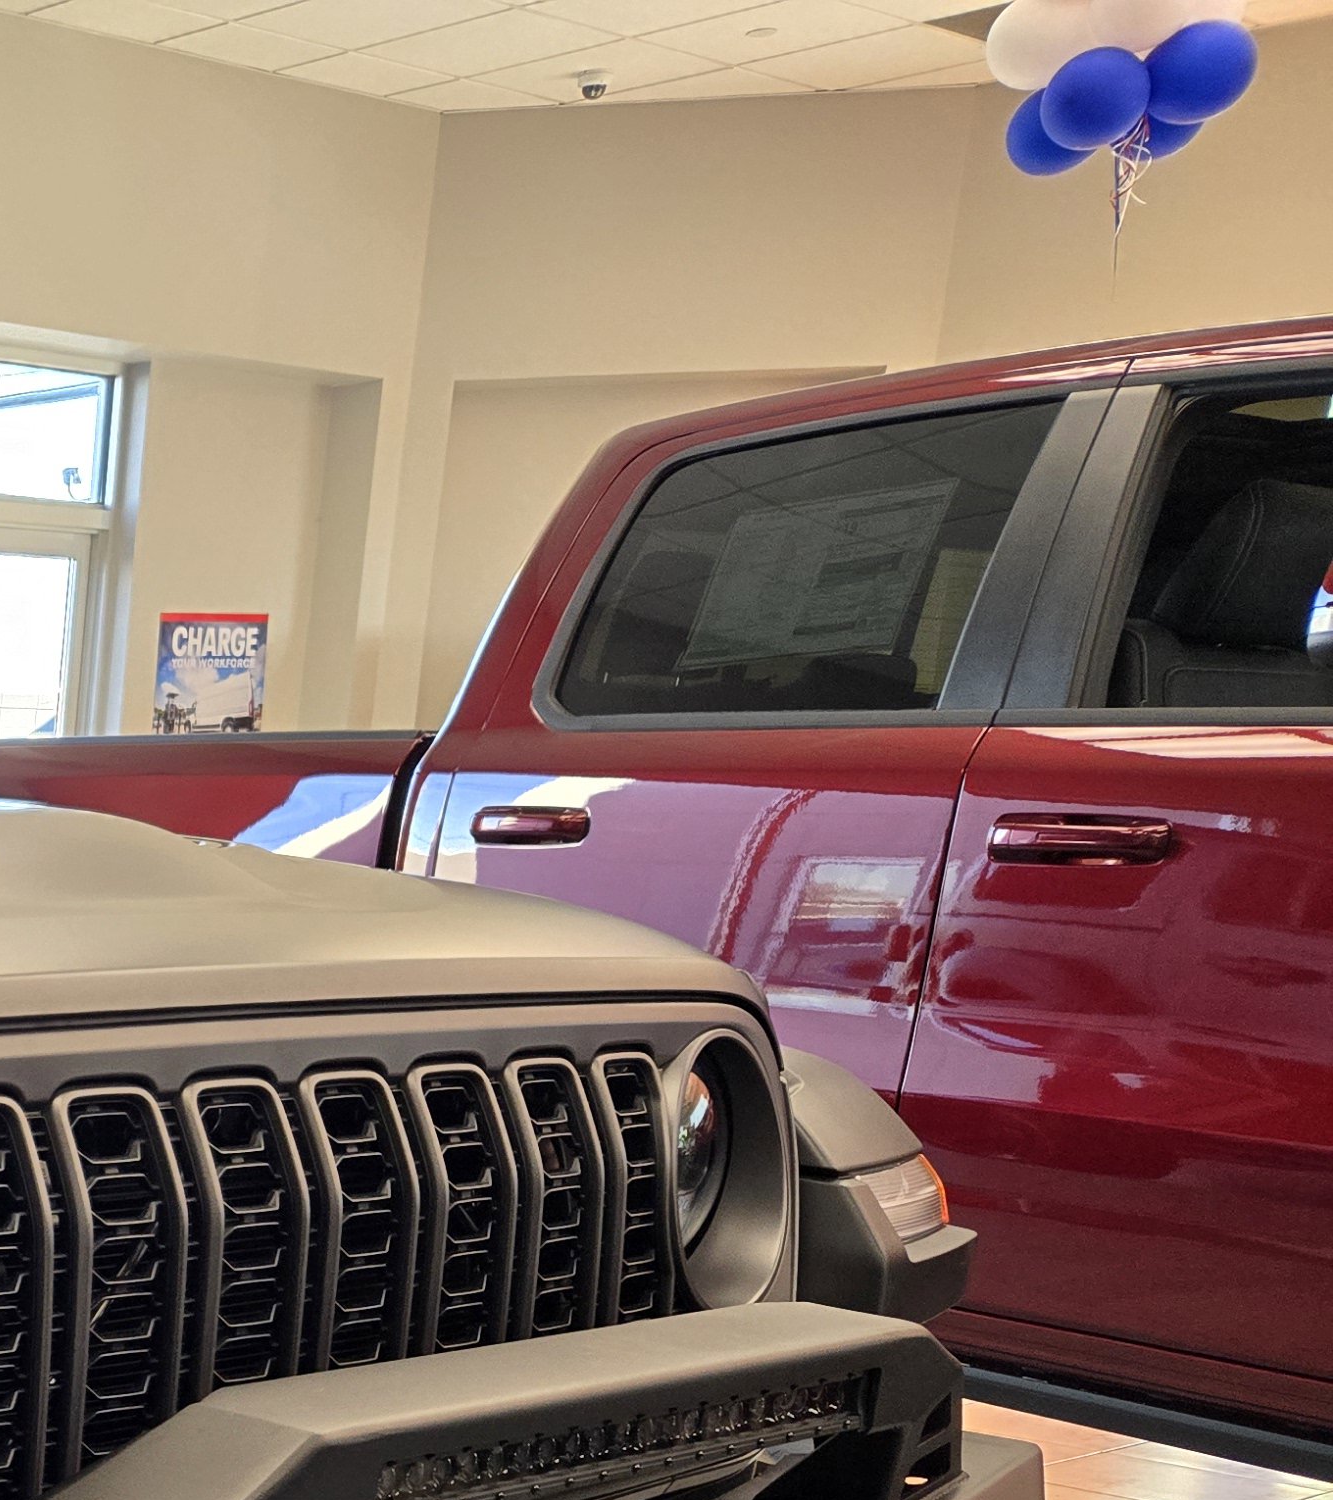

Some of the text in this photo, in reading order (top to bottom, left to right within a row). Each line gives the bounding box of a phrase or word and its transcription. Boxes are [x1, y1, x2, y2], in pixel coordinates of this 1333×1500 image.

[171, 625, 259, 657] CHARGE
[171, 658, 256, 669] YOUR WORKFORCE
